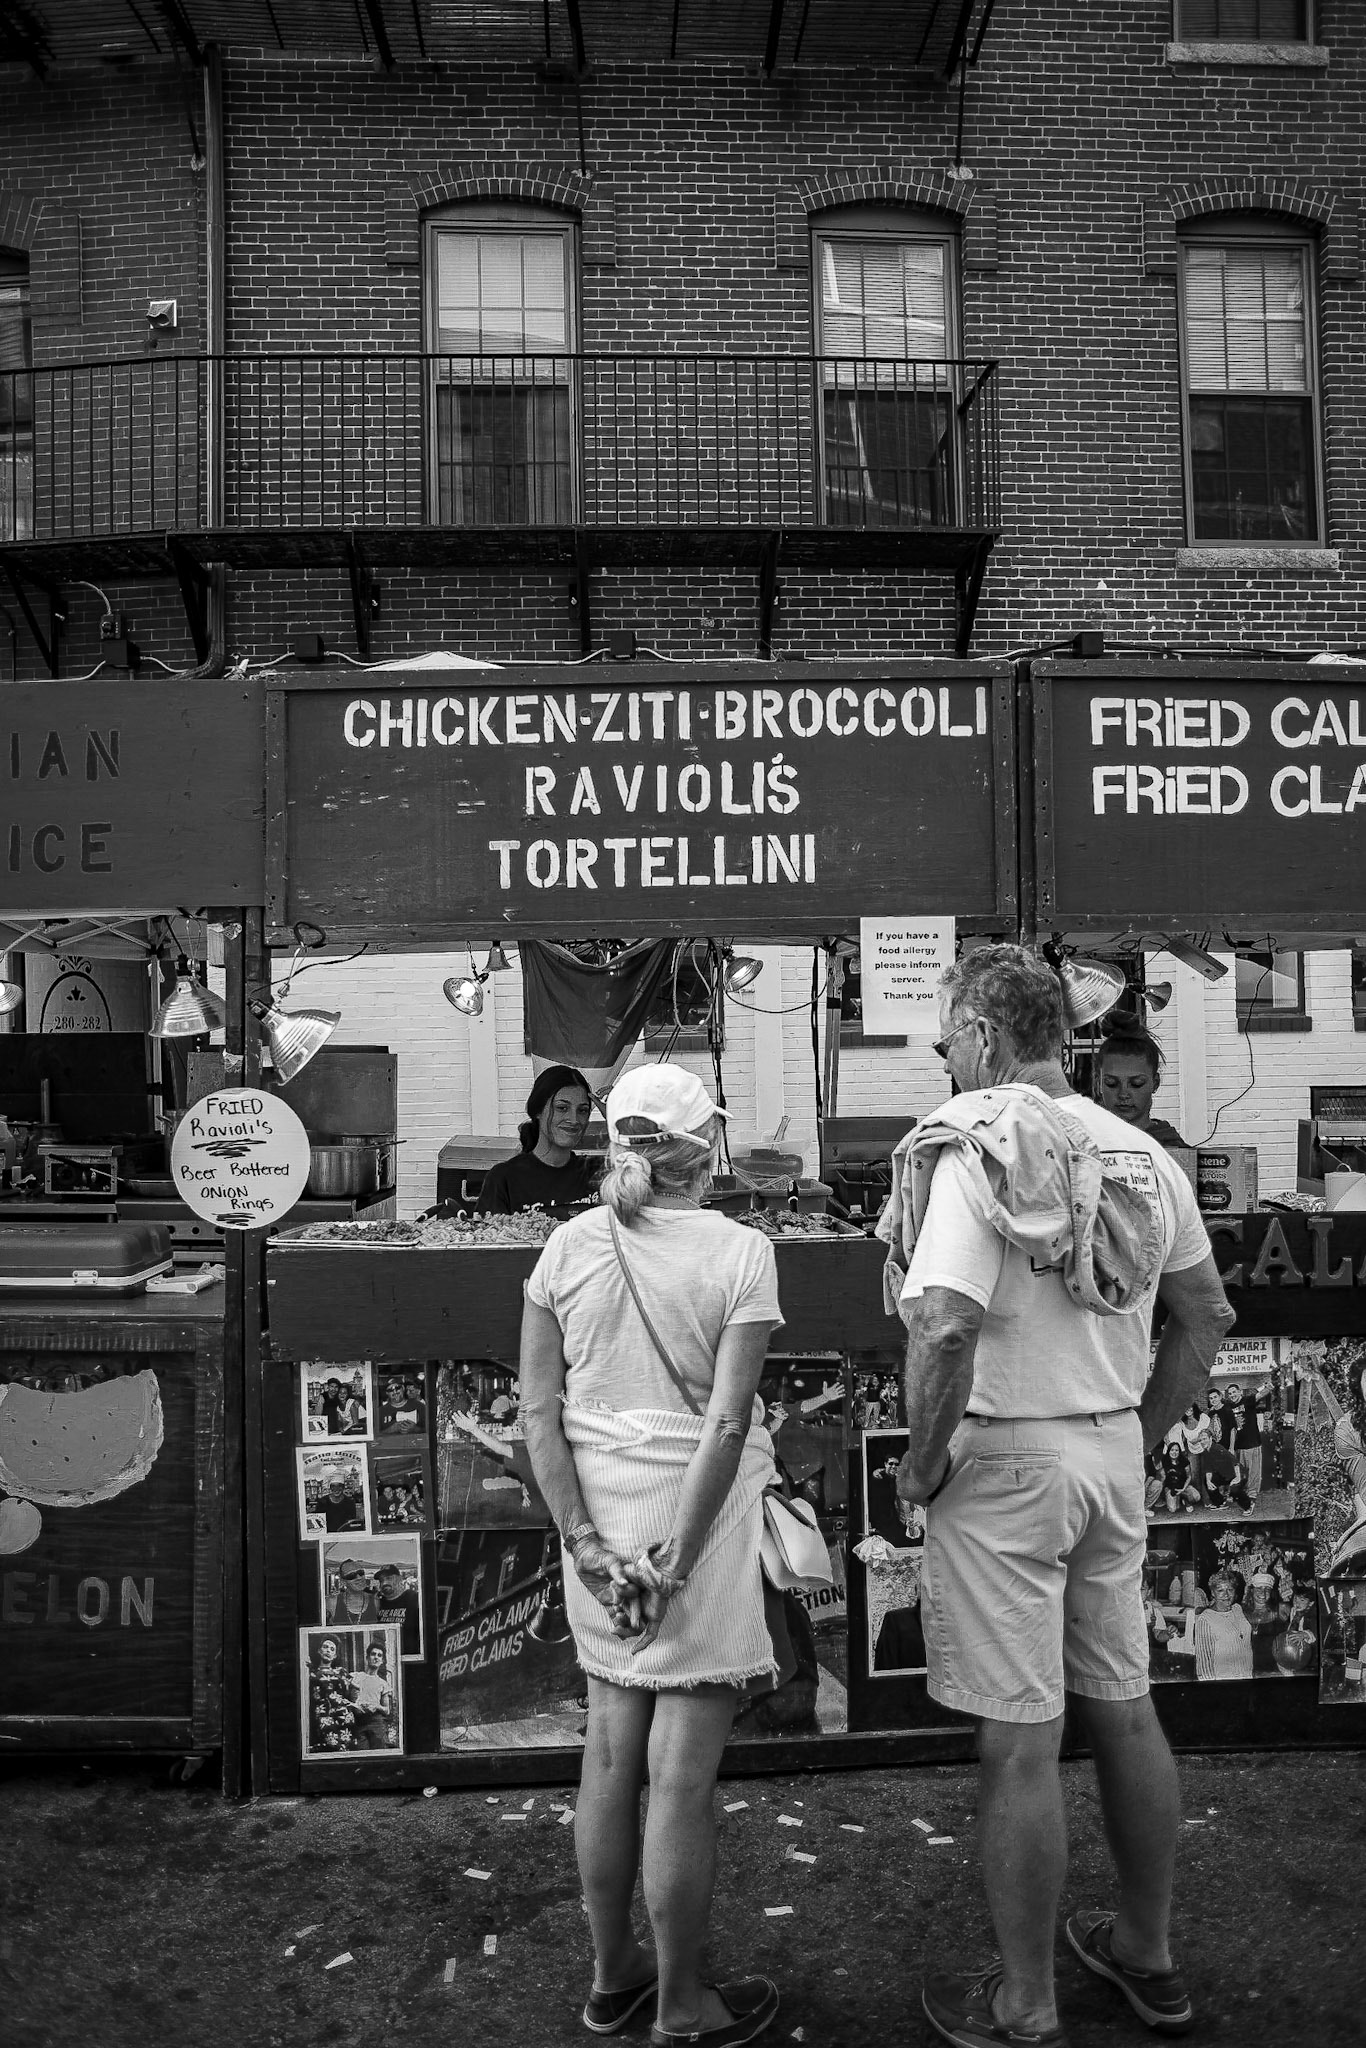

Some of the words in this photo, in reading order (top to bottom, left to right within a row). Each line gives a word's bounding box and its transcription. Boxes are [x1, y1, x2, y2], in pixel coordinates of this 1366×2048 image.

[10, 730, 121, 782] IAN
[8, 822, 113, 874] ICE
[489, 834, 816, 889] TORTELLINI
[876, 931, 884, 940] If
[885, 933, 904, 942] you
[906, 931, 930, 940] have
[878, 946, 901, 954] food
[903, 946, 937, 956] allergy
[874, 961, 907, 971] please
[909, 960, 941, 969] inform
[882, 991, 914, 1000] Thank
[916, 993, 934, 1001] you
[206, 1097, 264, 1115] FRIED
[190, 1117, 273, 1137] Ravioli's
[180, 1164, 218, 1181] Beer
[229, 1162, 290, 1177] Battered
[230, 1198, 275, 1212] Rings
[1204, 1217, 1366, 1287] CAL
[1227, 1354, 1268, 1365] SHRIMP
[470, 1630, 524, 1672] CLAMS
